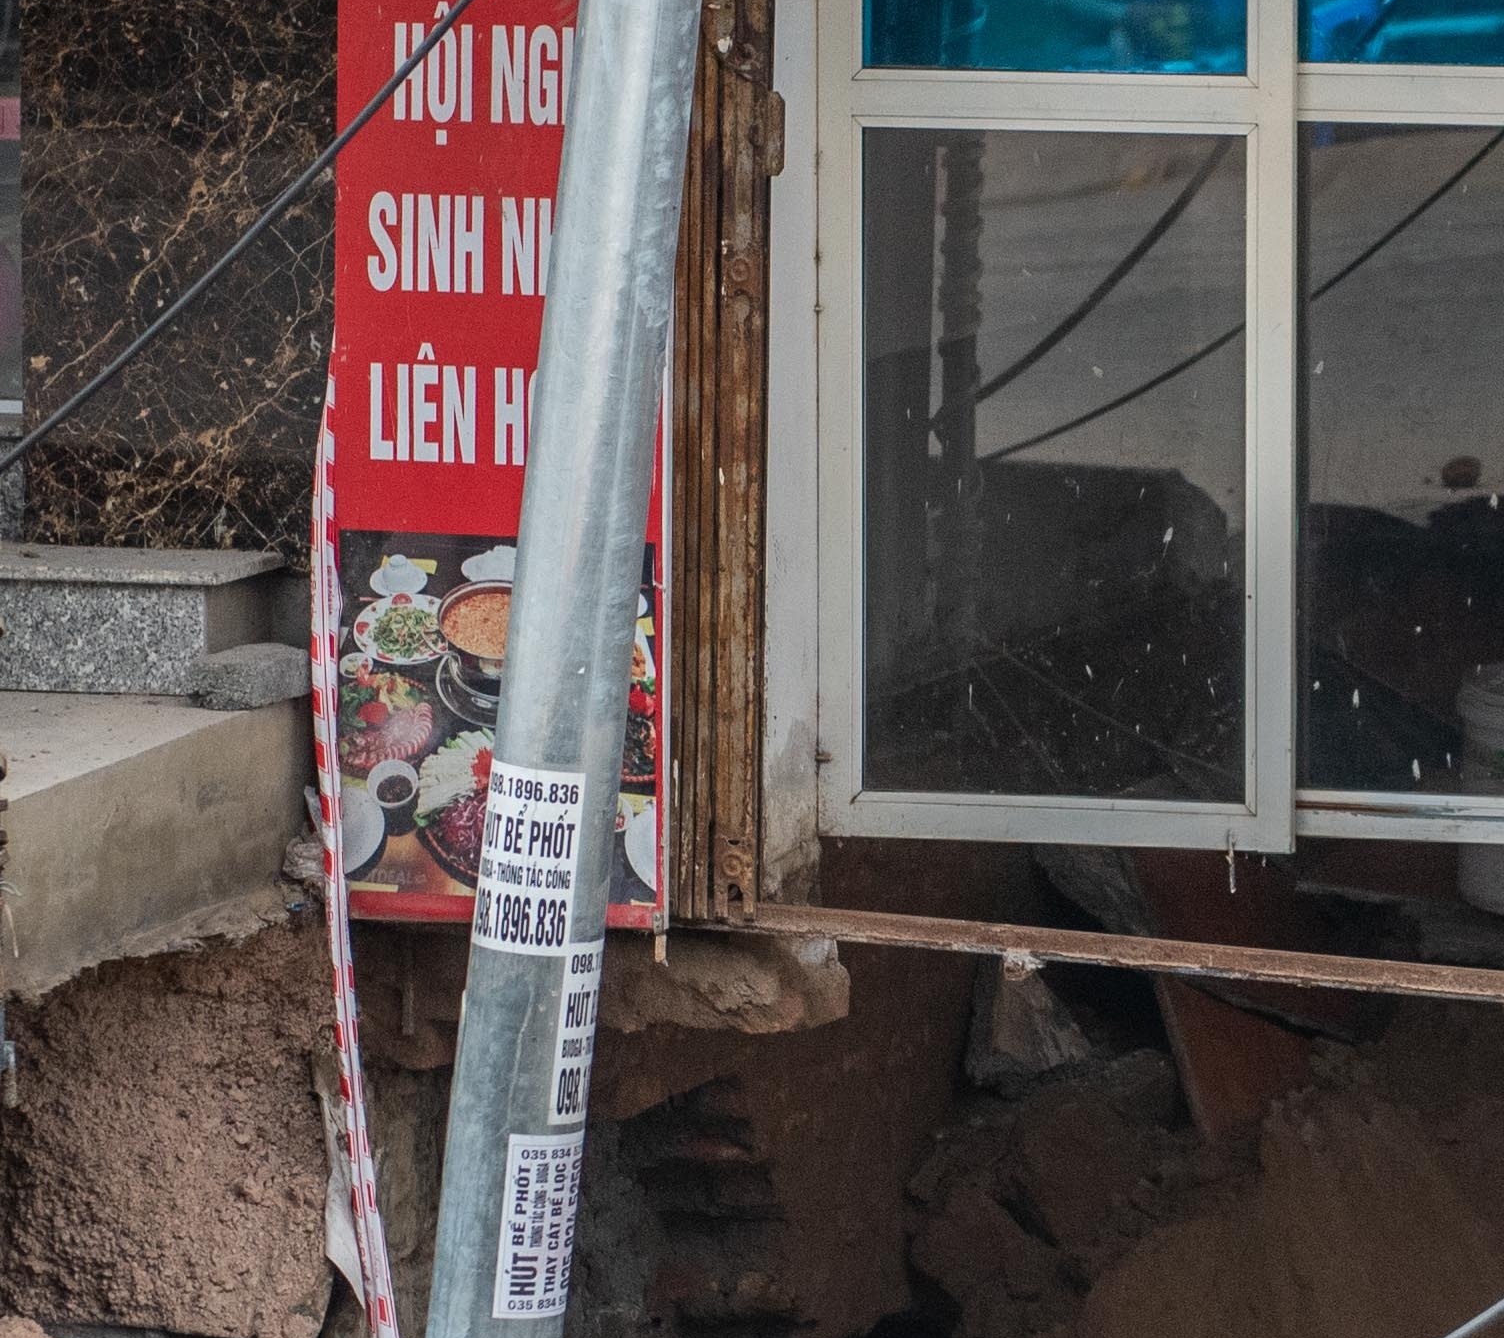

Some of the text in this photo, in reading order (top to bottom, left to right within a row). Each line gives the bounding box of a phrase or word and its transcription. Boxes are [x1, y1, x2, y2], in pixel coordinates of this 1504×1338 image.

[490, 23, 576, 127] NG
[367, 191, 485, 294] SINH
[369, 342, 477, 465] LIÊN
[504, 803, 526, 854] BỂ
[528, 810, 575, 859] PHỐT
[565, 984, 590, 1028] HÚT
[521, 1148, 547, 1160] 035
[551, 1148, 572, 1159] 834
[513, 1165, 531, 1215] PHỐT
[505, 1253, 538, 1296] HÚT
[544, 1257, 557, 1294] THAY
[508, 1299, 534, 1311] 035
